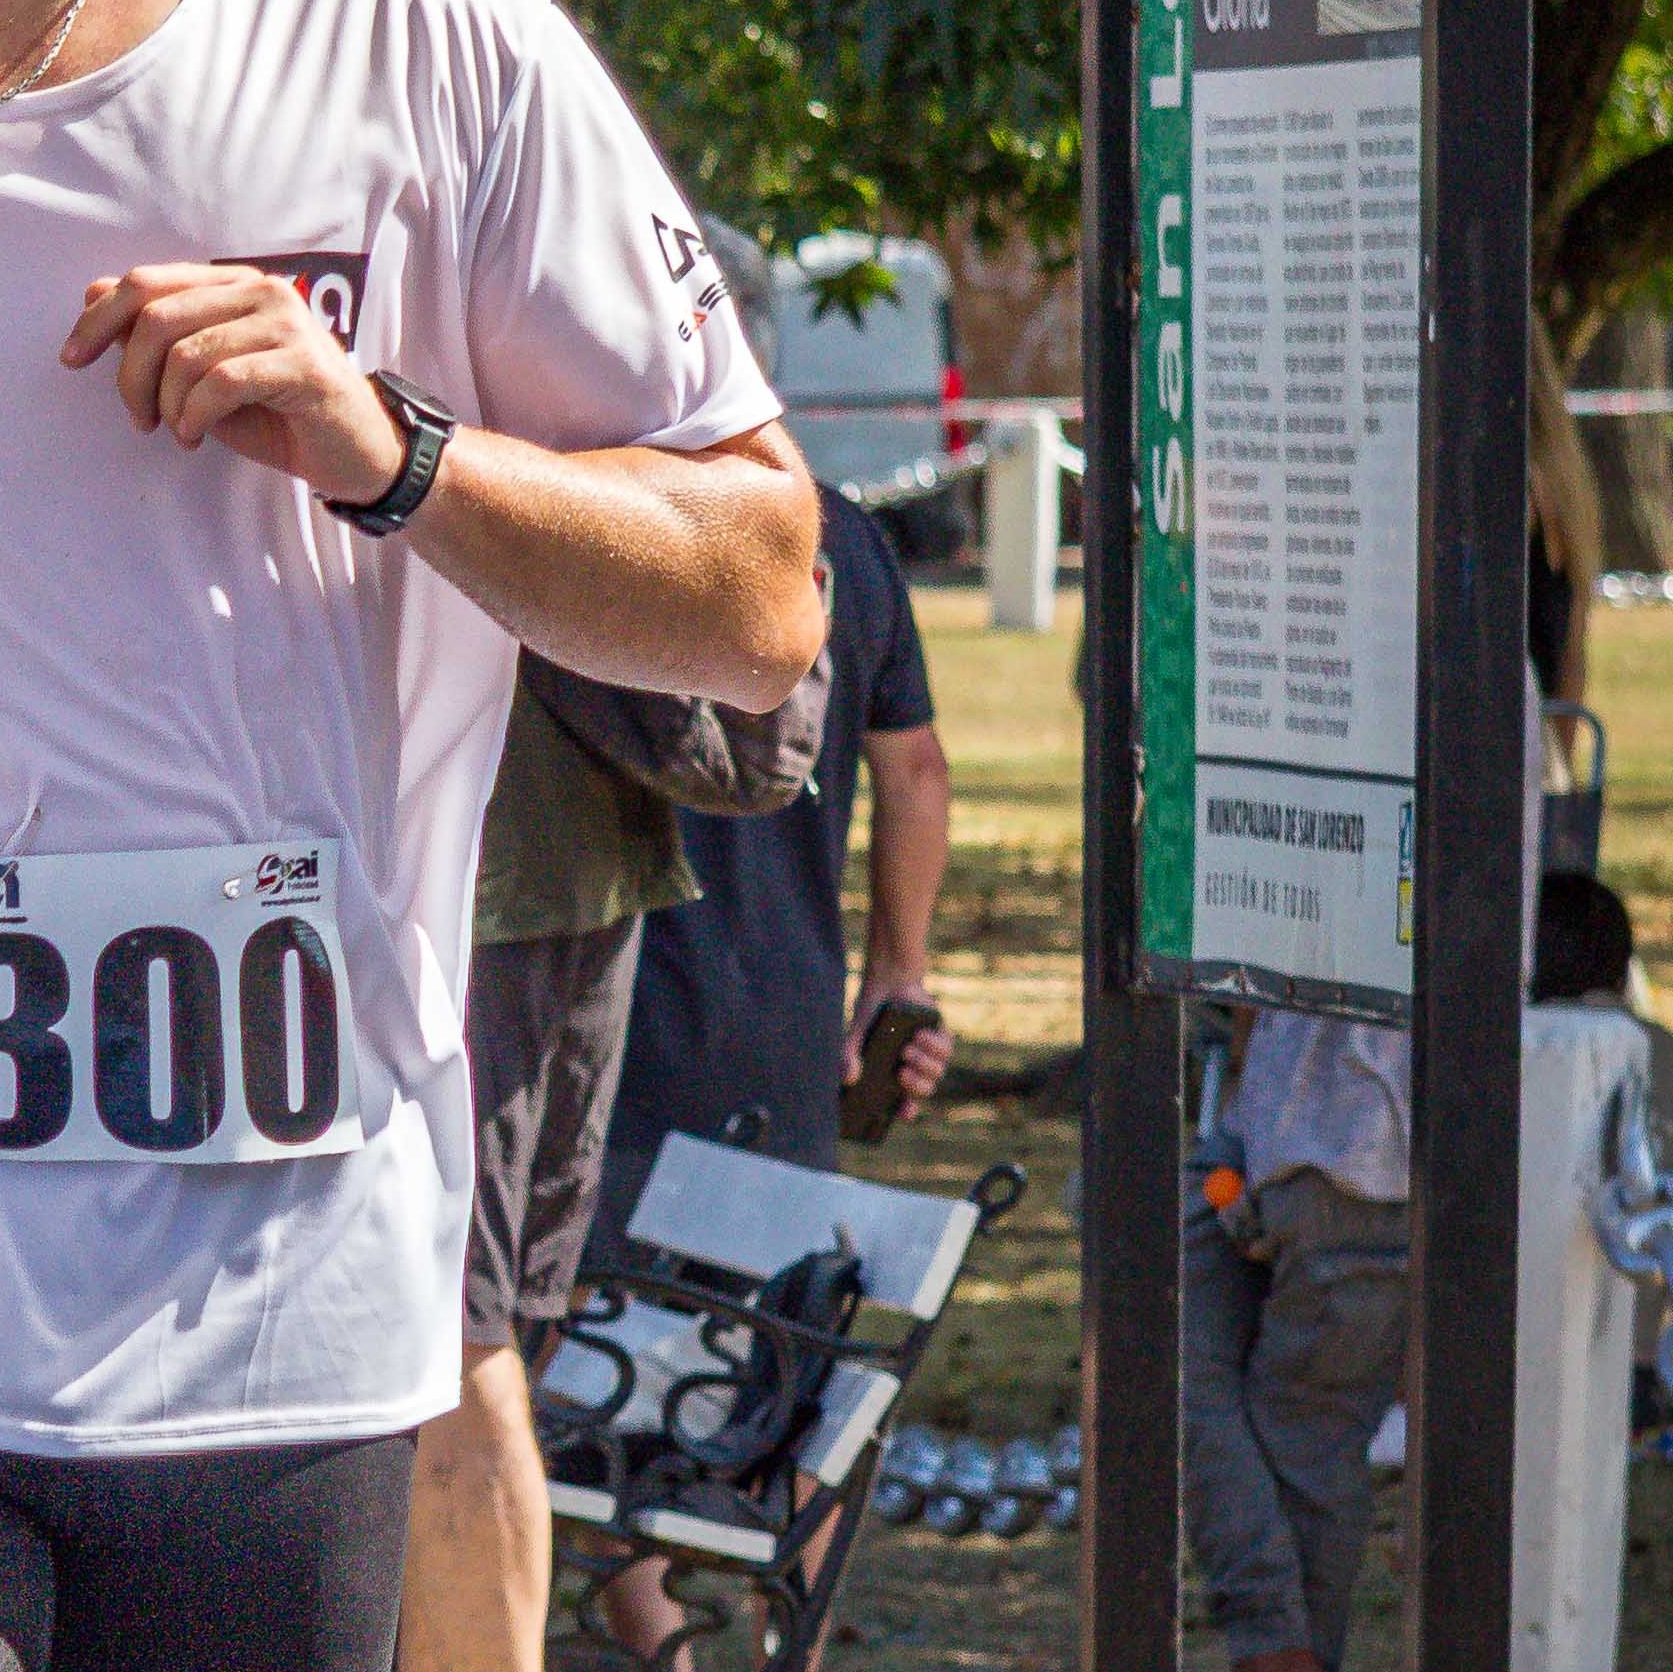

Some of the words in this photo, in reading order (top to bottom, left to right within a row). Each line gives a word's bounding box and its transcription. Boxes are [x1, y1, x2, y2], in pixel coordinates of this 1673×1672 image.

[1152, 194, 1184, 536] San
[1206, 798, 1281, 842] MUNICIPALIDAD
[1284, 805, 1297, 846] DE
[1298, 806, 1315, 850] SAN
[1317, 810, 1365, 855] LORENZO
[1262, 879, 1277, 915] DE
